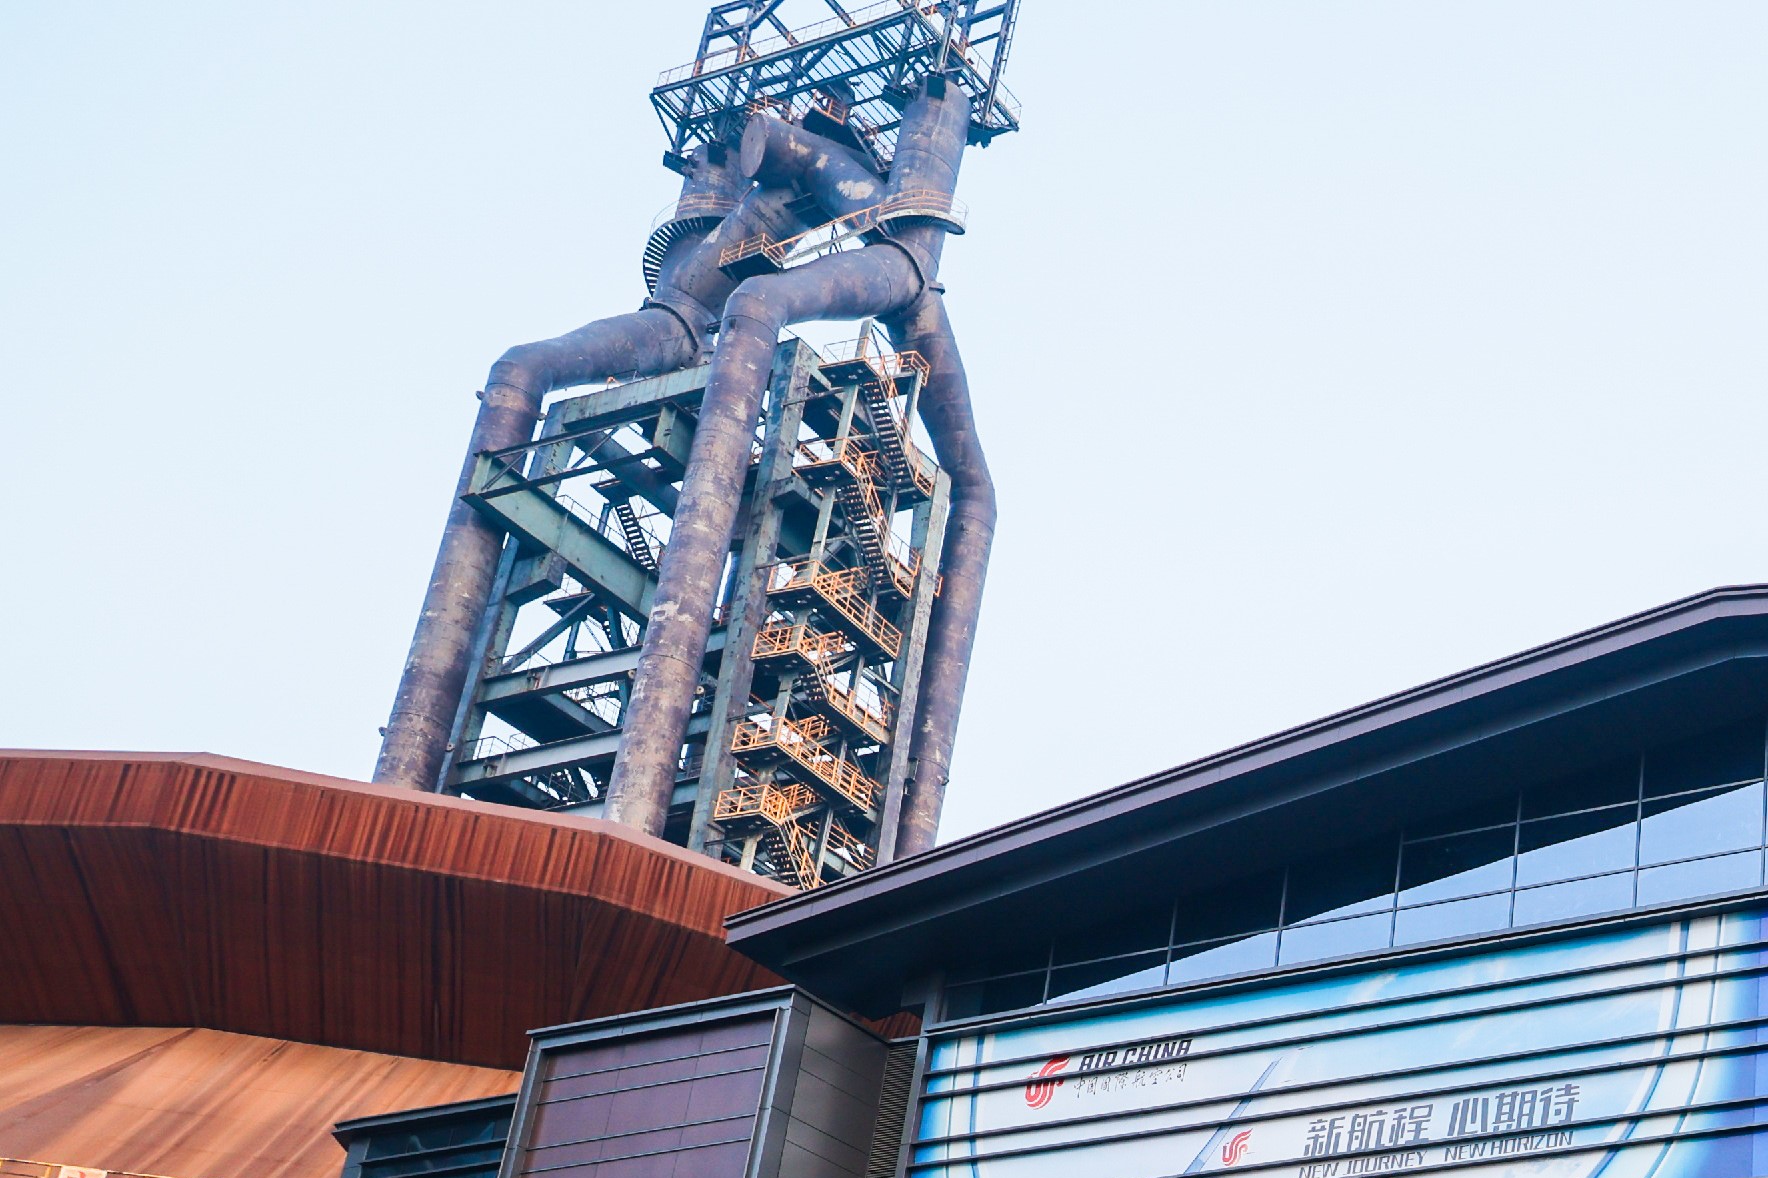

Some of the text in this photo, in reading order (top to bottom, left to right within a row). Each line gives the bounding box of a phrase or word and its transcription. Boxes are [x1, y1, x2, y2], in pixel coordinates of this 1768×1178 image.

[1079, 1039, 1193, 1071] AIR CHINA
[1304, 1084, 1580, 1156] 新航程 心期待
[1343, 1150, 1427, 1176] JOURNEY
[1444, 1142, 1487, 1162] NEW
[1490, 1131, 1573, 1156] HORIZON
